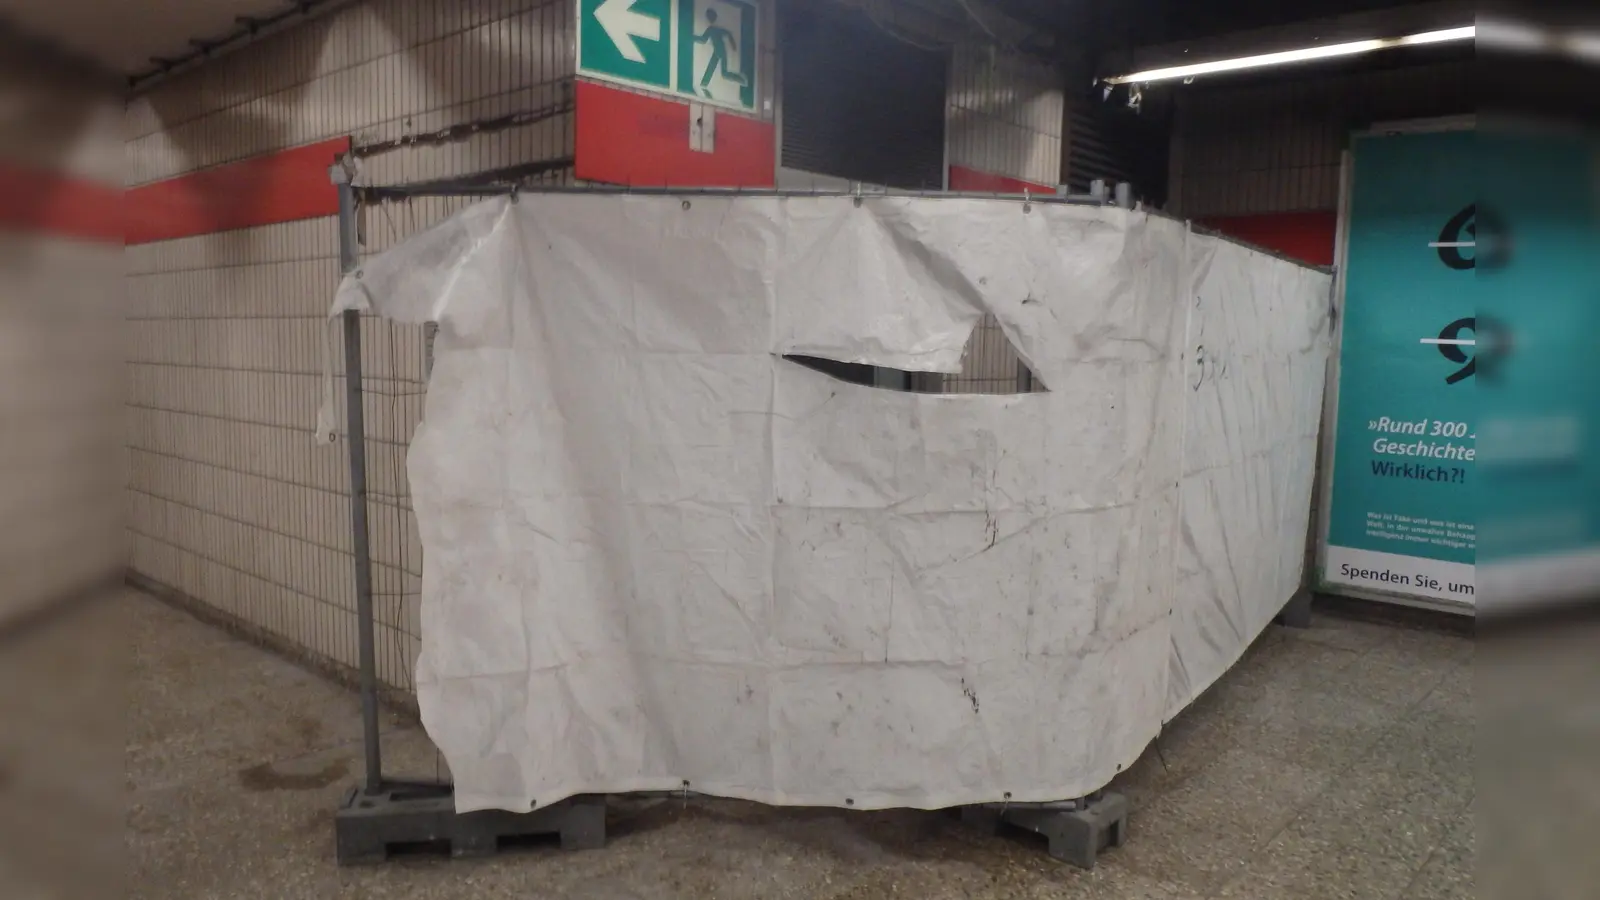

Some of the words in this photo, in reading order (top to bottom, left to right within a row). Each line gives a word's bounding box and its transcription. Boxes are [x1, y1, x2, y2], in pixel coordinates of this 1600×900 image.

[1368, 416, 1428, 435] »Rund
[1429, 420, 1467, 439] 300
[1373, 437, 1475, 461] Geschichte
[1372, 460, 1465, 483] Wirklich?!
[1341, 563, 1409, 585] Spenden
[1415, 574, 1443, 591] Sie,
[1449, 583, 1474, 595] um
